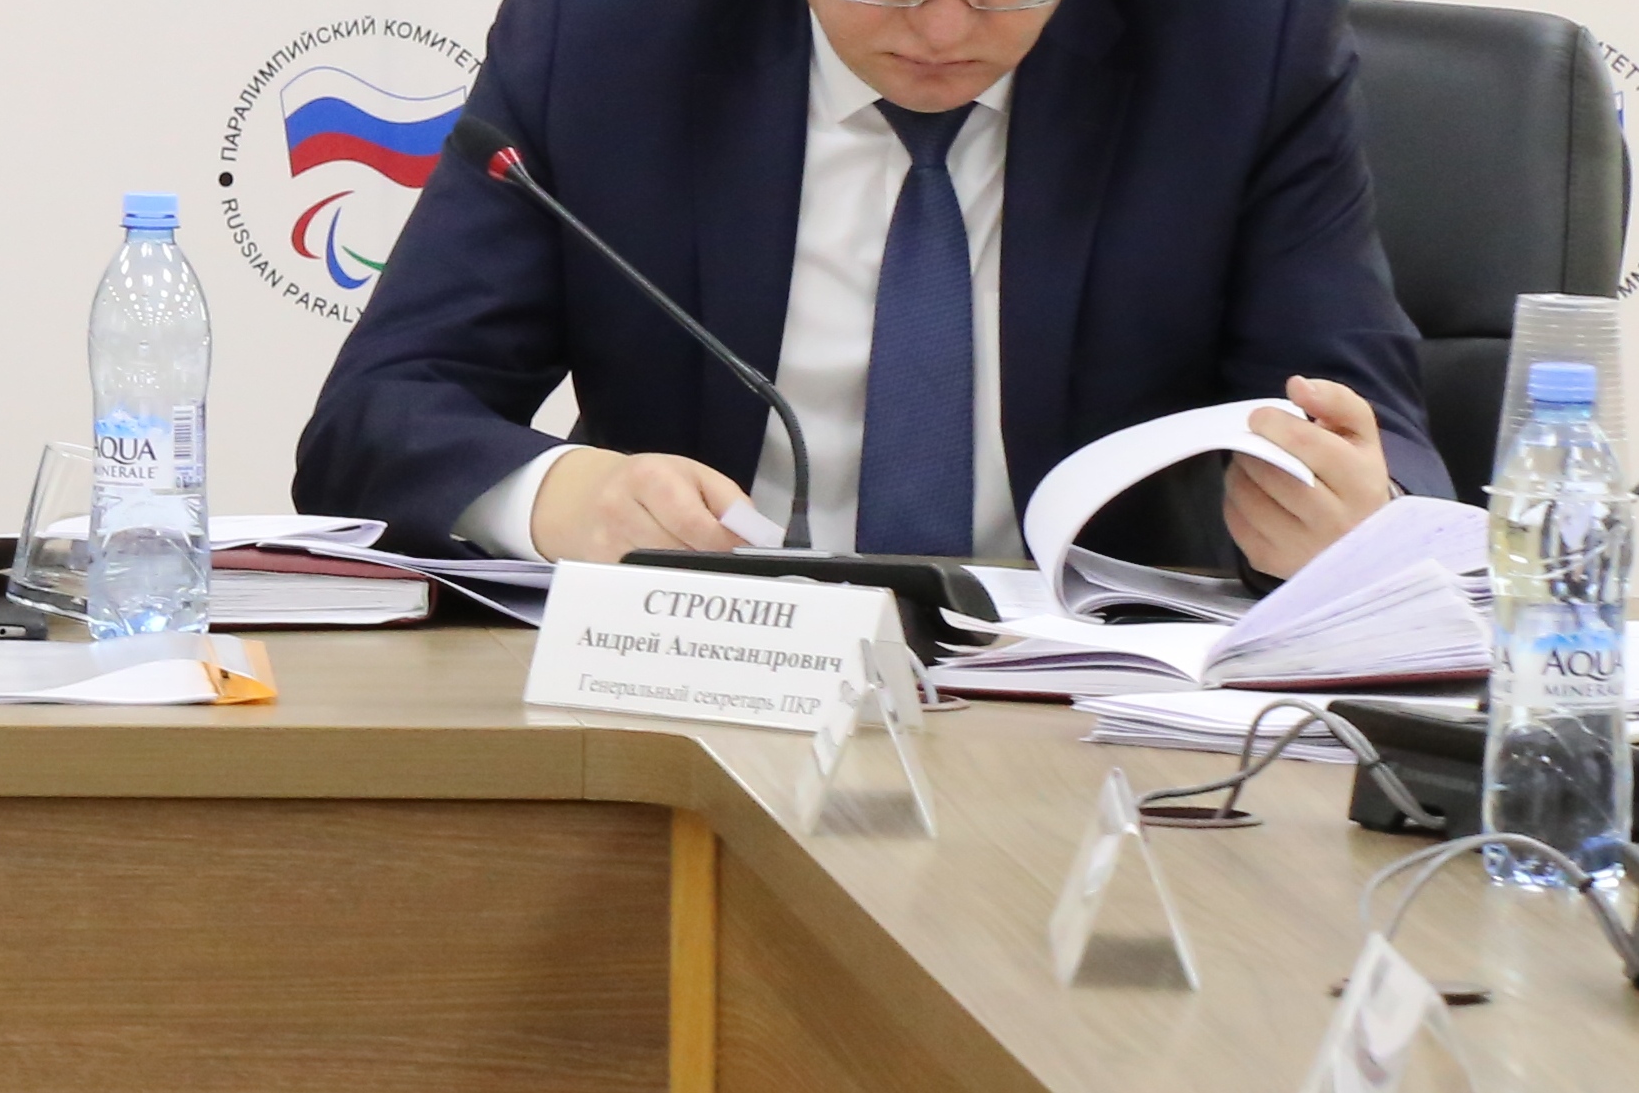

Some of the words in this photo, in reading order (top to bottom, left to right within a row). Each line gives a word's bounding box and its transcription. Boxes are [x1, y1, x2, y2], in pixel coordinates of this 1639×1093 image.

[221, 16, 376, 161] ПАРАЛИМПИЙСКИЙ
[384, 19, 483, 76] КОМИТЕТ
[221, 198, 284, 288] RUSSIAN
[643, 589, 799, 629] СТРОКИН
[577, 627, 661, 657] Андрей
[665, 636, 842, 674] Александрович
[578, 674, 690, 704] Генеральный
[693, 687, 774, 714] секретарь
[780, 694, 822, 715] ПКР
